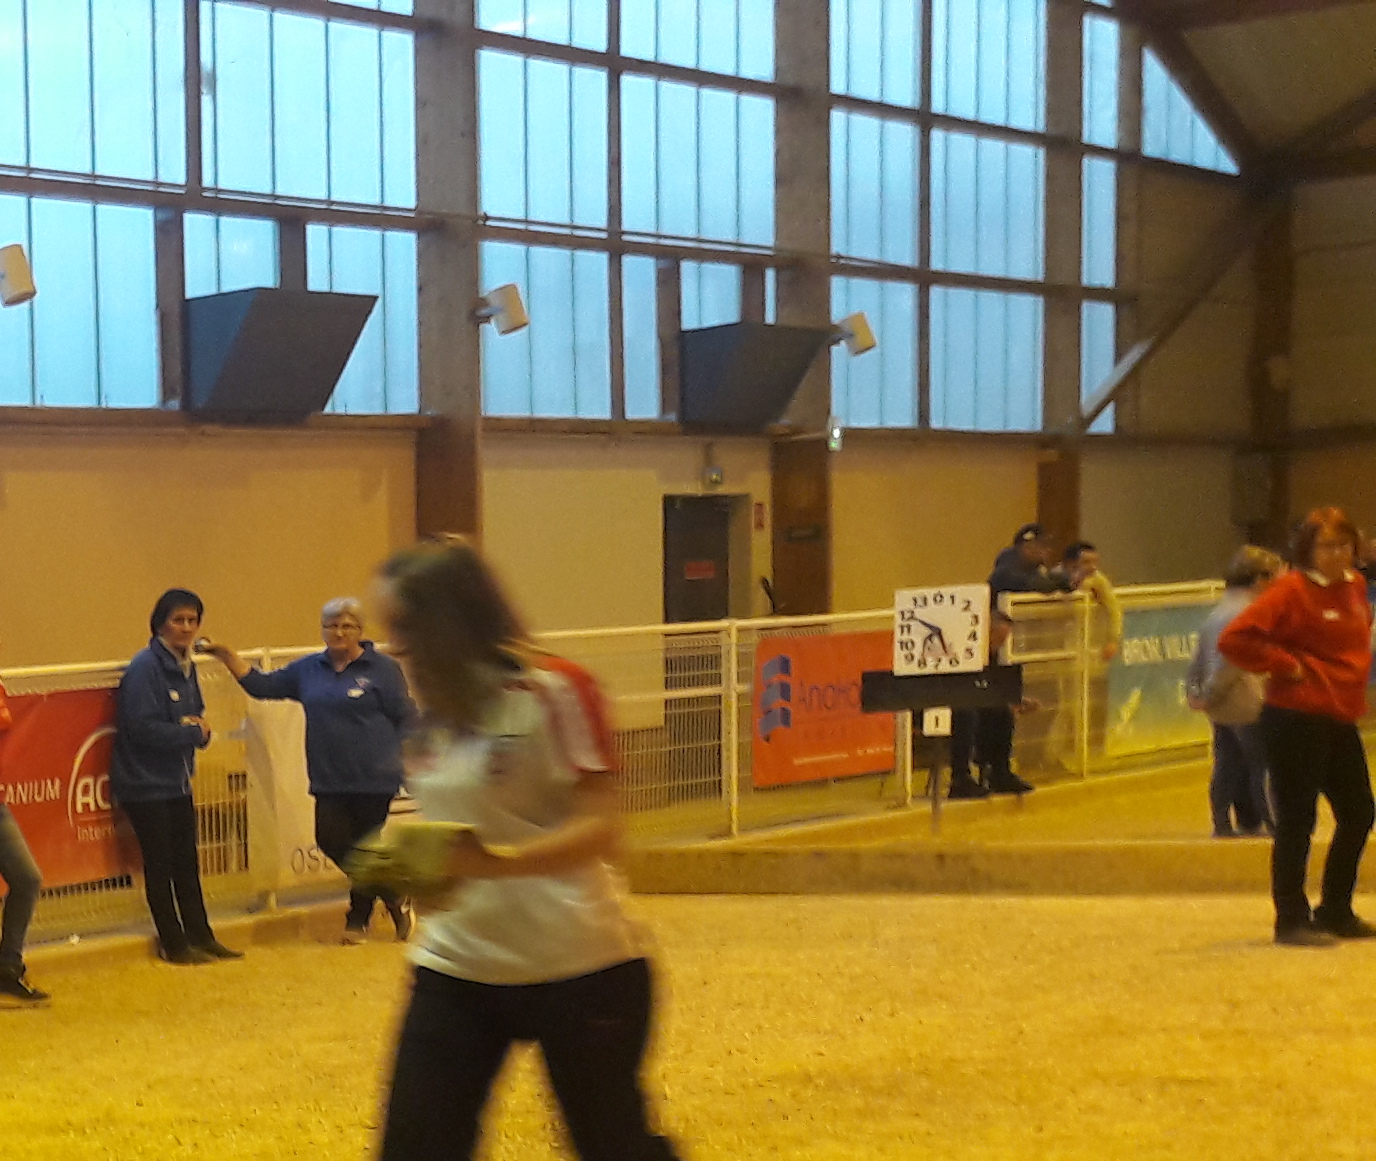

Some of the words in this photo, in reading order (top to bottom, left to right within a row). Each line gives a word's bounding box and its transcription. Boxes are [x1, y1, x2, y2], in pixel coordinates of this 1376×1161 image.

[933, 591, 944, 605] 0
[962, 599, 971, 612] 2
[970, 613, 980, 626] 3
[898, 624, 912, 637] 11
[967, 629, 978, 641] 4
[898, 639, 915, 652] 10
[904, 652, 915, 665] 9
[964, 647, 974, 660] 5
[918, 656, 927, 669] 8
[949, 655, 960, 667] 6
